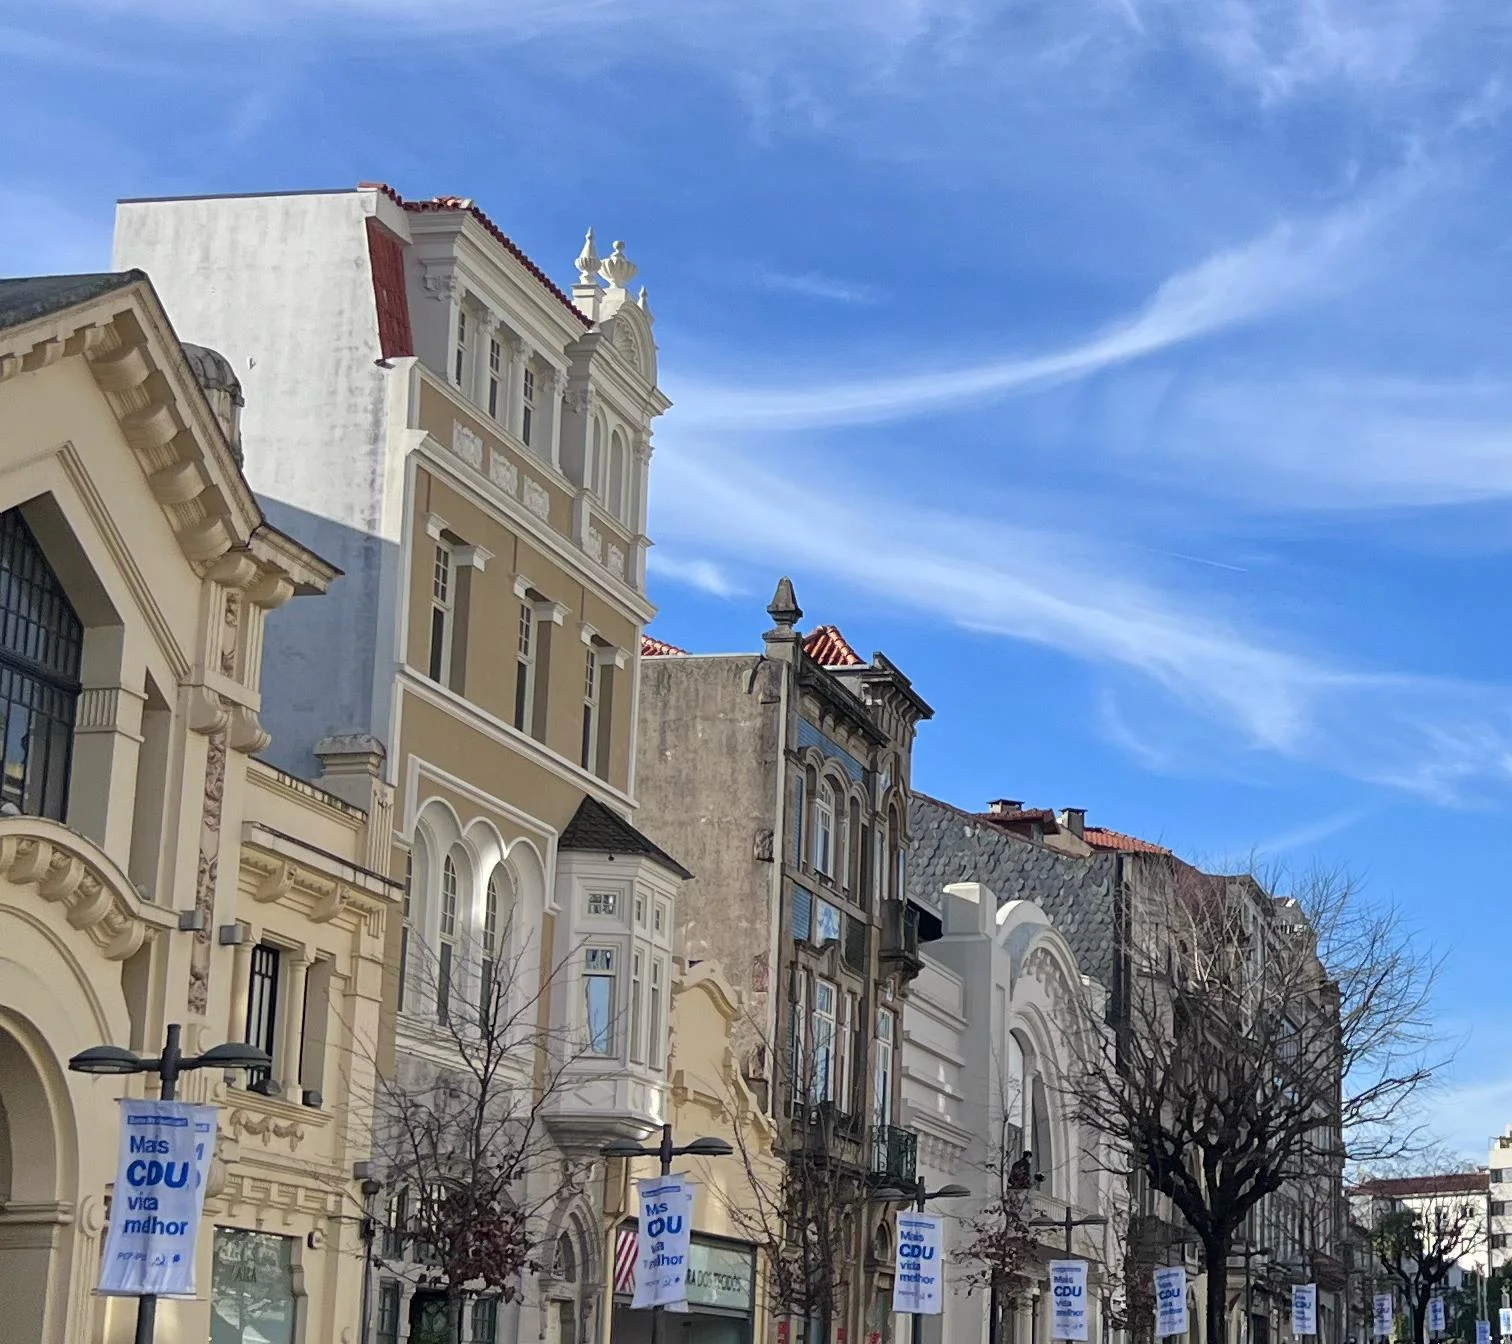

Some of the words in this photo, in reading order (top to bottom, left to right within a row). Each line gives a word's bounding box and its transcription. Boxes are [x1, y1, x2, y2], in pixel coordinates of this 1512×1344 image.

[130, 1135, 169, 1154] Mais
[126, 1159, 189, 1188] CDU
[900, 1230, 924, 1241] Mais
[899, 1244, 934, 1259] CDU
[900, 1261, 920, 1270] vida
[900, 1273, 934, 1284] melhor
[1054, 1286, 1081, 1297] CDU
